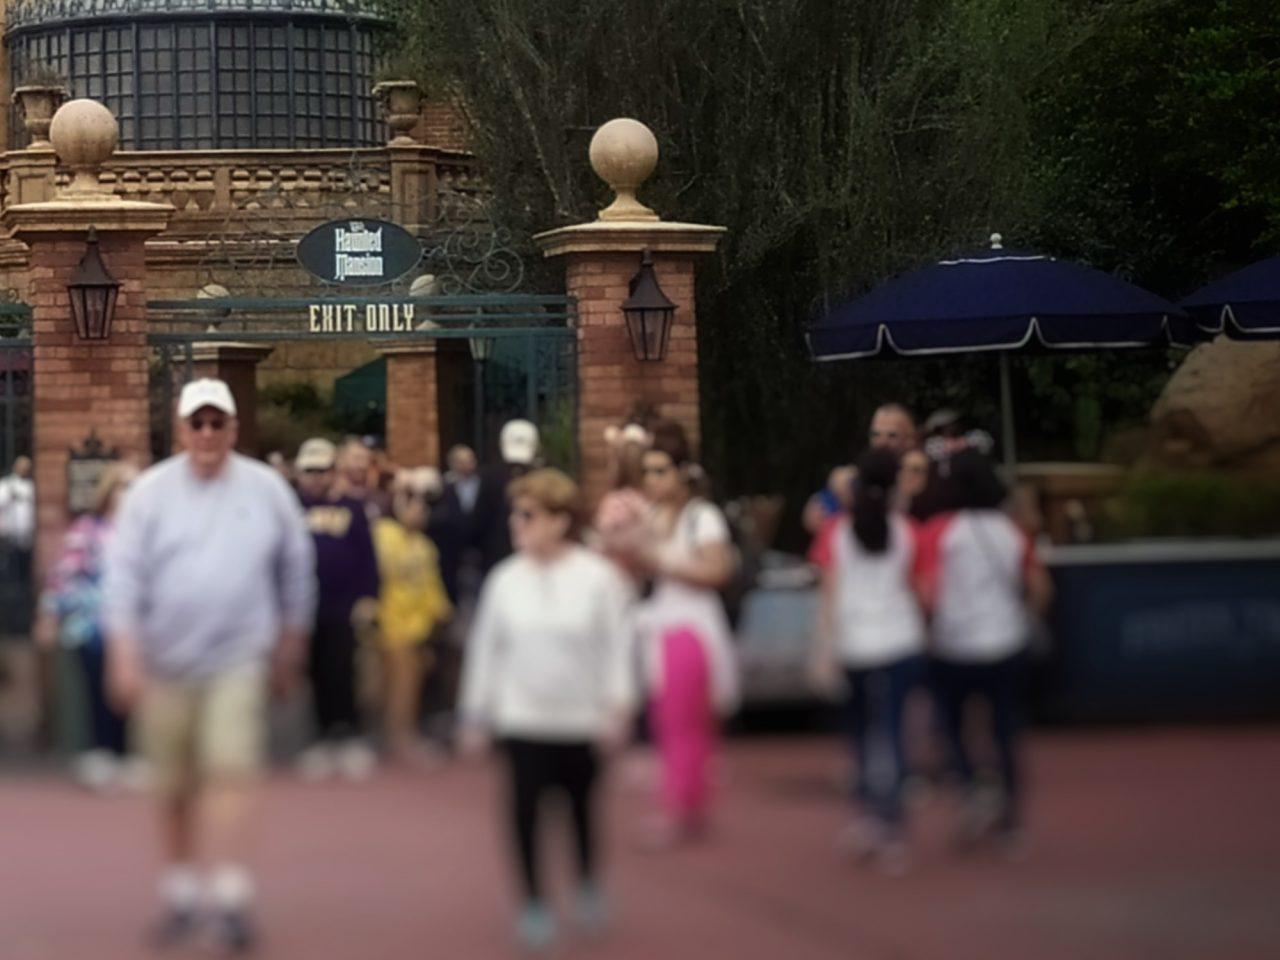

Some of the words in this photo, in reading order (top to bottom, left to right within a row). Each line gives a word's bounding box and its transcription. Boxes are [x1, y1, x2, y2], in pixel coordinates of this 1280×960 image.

[335, 227, 382, 252] Haunted
[334, 253, 385, 281] Mansion
[309, 304, 356, 332] EXIT
[366, 303, 414, 332] ONLY
